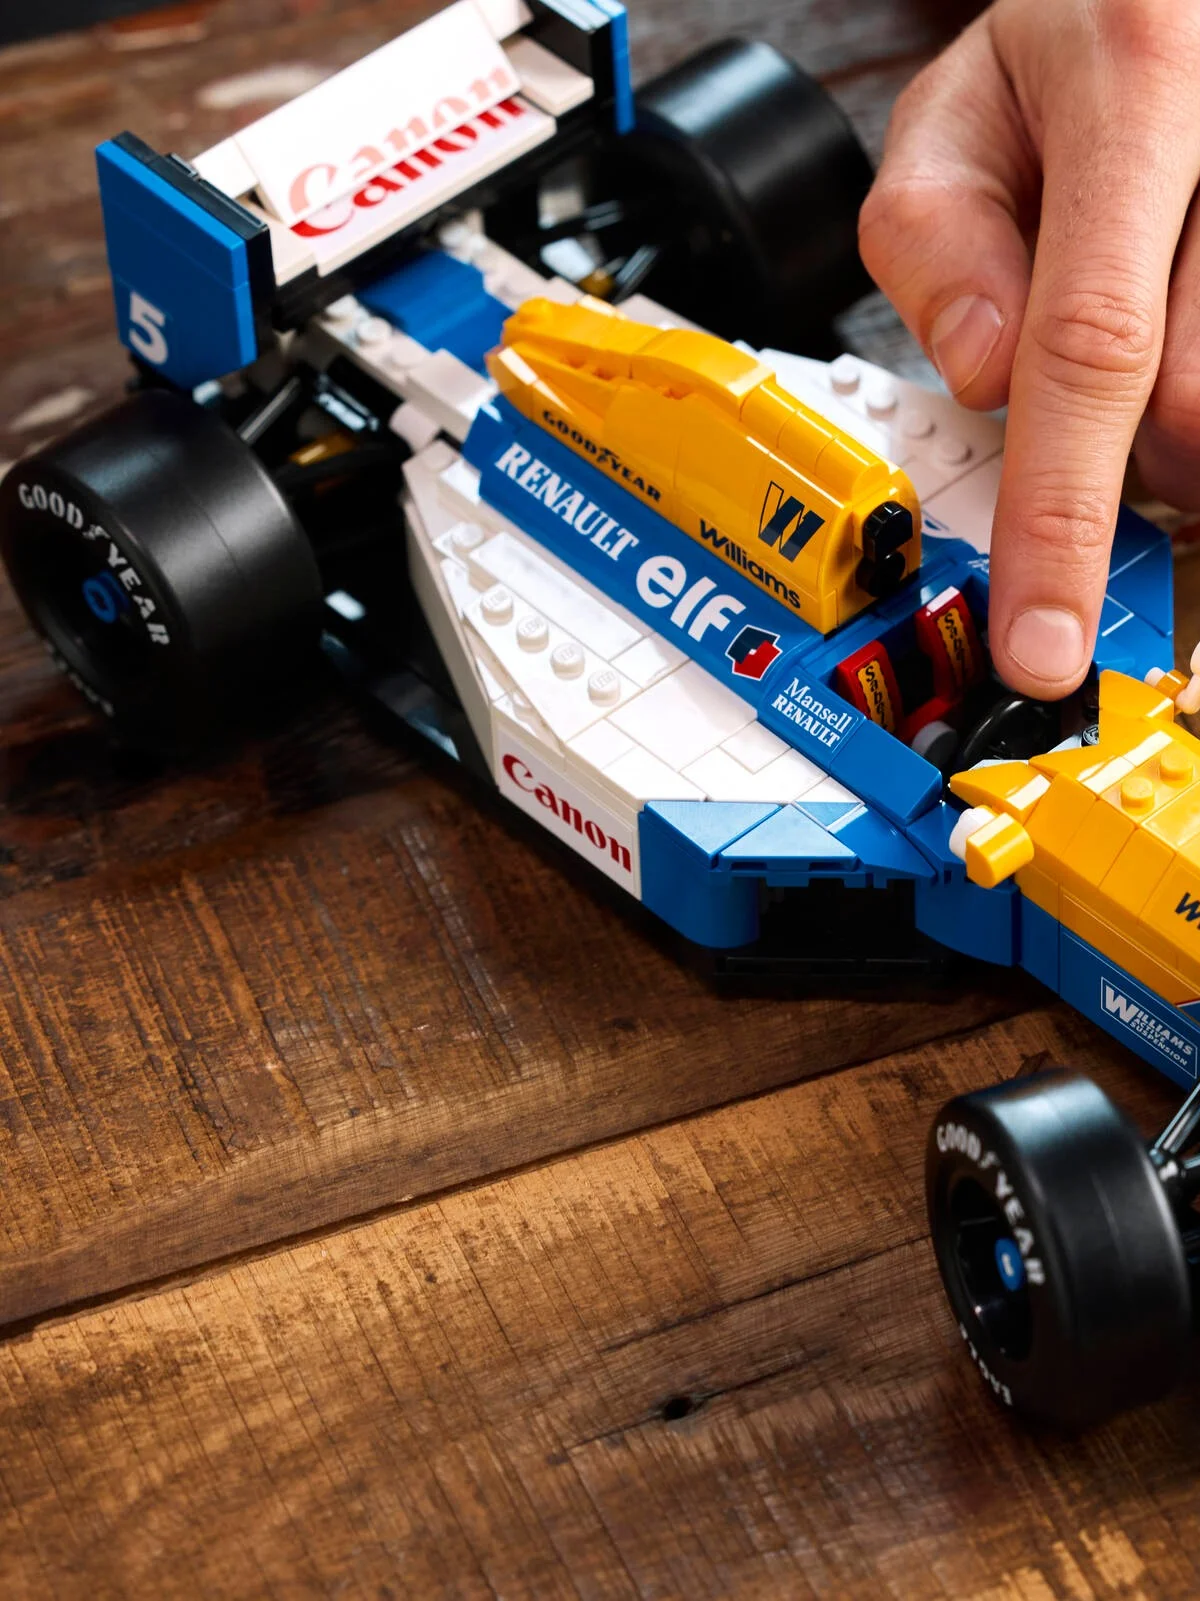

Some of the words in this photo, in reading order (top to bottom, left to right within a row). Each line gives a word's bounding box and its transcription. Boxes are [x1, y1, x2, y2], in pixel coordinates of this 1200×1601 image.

[288, 66, 526, 238] Canon
[128, 294, 169, 366] 5
[543, 409, 661, 502] GOODYEAR
[495, 442, 639, 561] RENAULT
[18, 482, 170, 645] GOODYEAR
[636, 555, 747, 643] elf
[700, 517, 802, 610] Williams
[771, 693, 841, 747] RENAULT
[783, 677, 853, 733] Mansell
[502, 753, 632, 873] Canon
[1105, 984, 1194, 1055] WILLIAMS
[1130, 1021, 1188, 1066] SUSPENSION
[1133, 1018, 1167, 1043] ACTIVE
